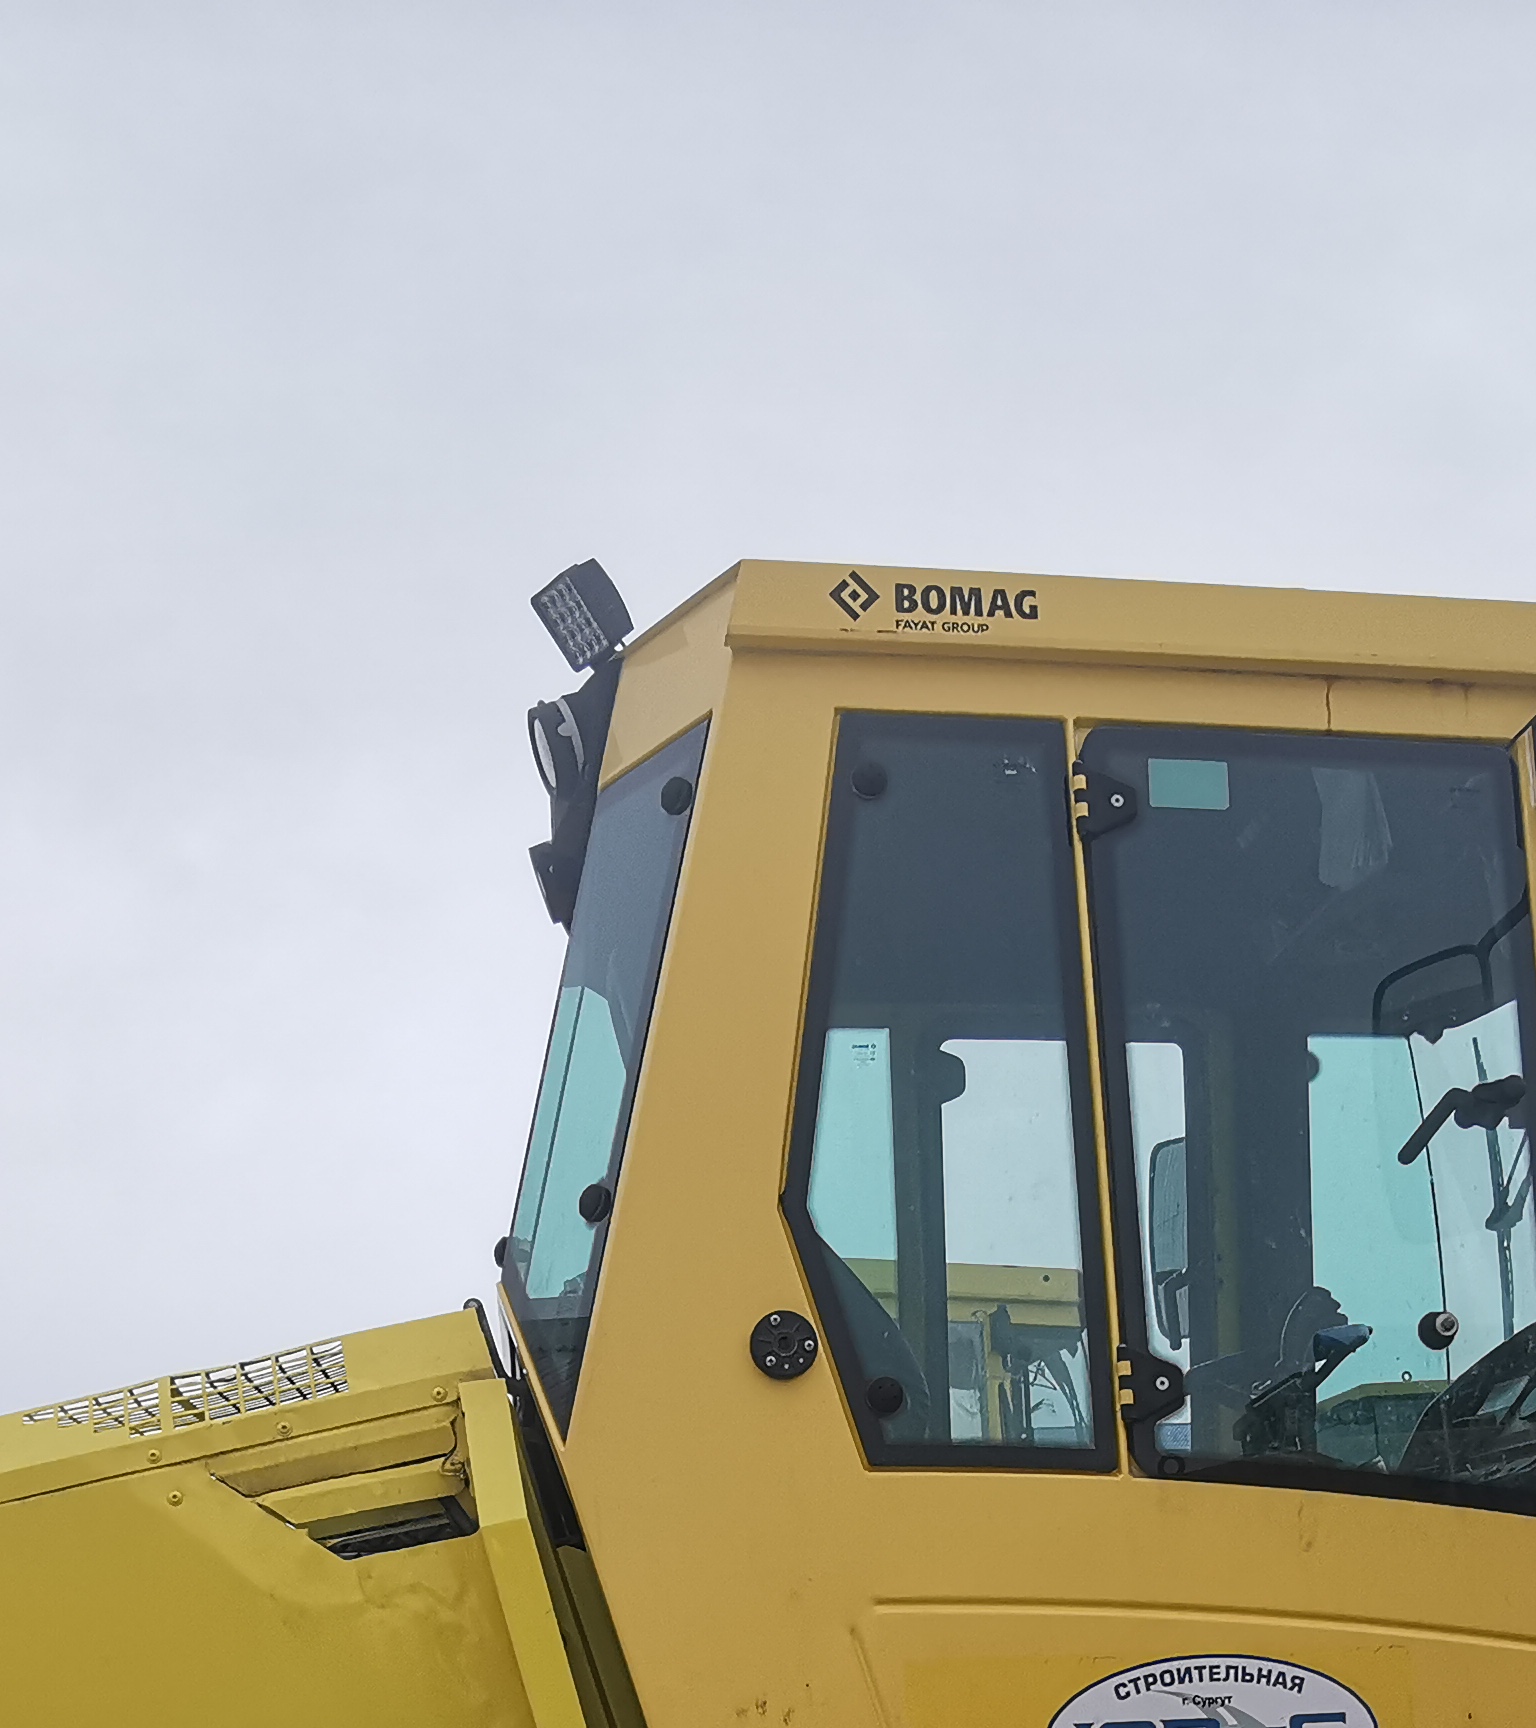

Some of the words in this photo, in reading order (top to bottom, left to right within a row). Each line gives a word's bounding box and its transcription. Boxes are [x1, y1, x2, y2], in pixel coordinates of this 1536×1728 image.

[894, 583, 1039, 620] BOMAG
[895, 619, 937, 632] FAYAT
[941, 622, 990, 634] GROUP
[1113, 1663, 1306, 1702] СТРОИТЕЛЬНАЯ
[1192, 1694, 1233, 1708] Сургут
